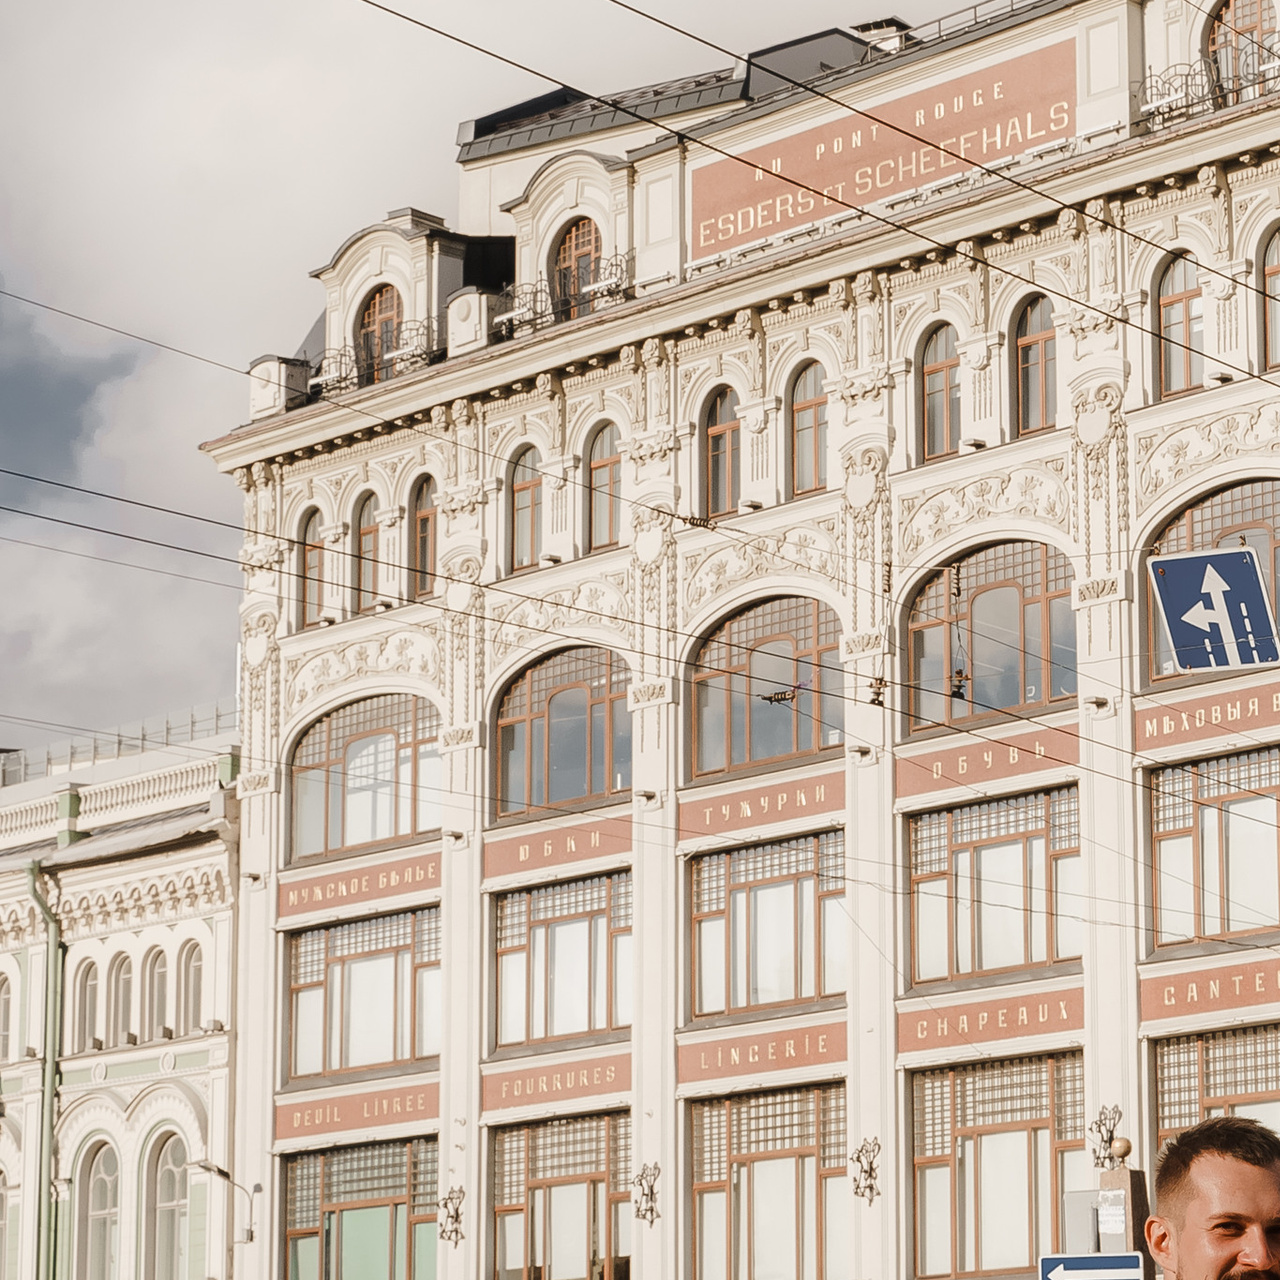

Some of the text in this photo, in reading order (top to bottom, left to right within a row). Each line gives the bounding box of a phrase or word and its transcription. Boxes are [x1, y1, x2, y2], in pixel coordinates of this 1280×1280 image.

[755, 81, 1004, 182] AU PONT ROUGE
[699, 101, 1070, 248] ESDERS ET SCHEEFHALS
[932, 740, 1046, 780] ОБУВЬ
[703, 784, 826, 826] ТУЖУРКИ
[518, 830, 600, 862] ЮБКИ
[288, 875, 370, 907] МУЖСКОЕ
[916, 1000, 1069, 1039] CHAPEAUX
[501, 1065, 616, 1099] FOURRURES
